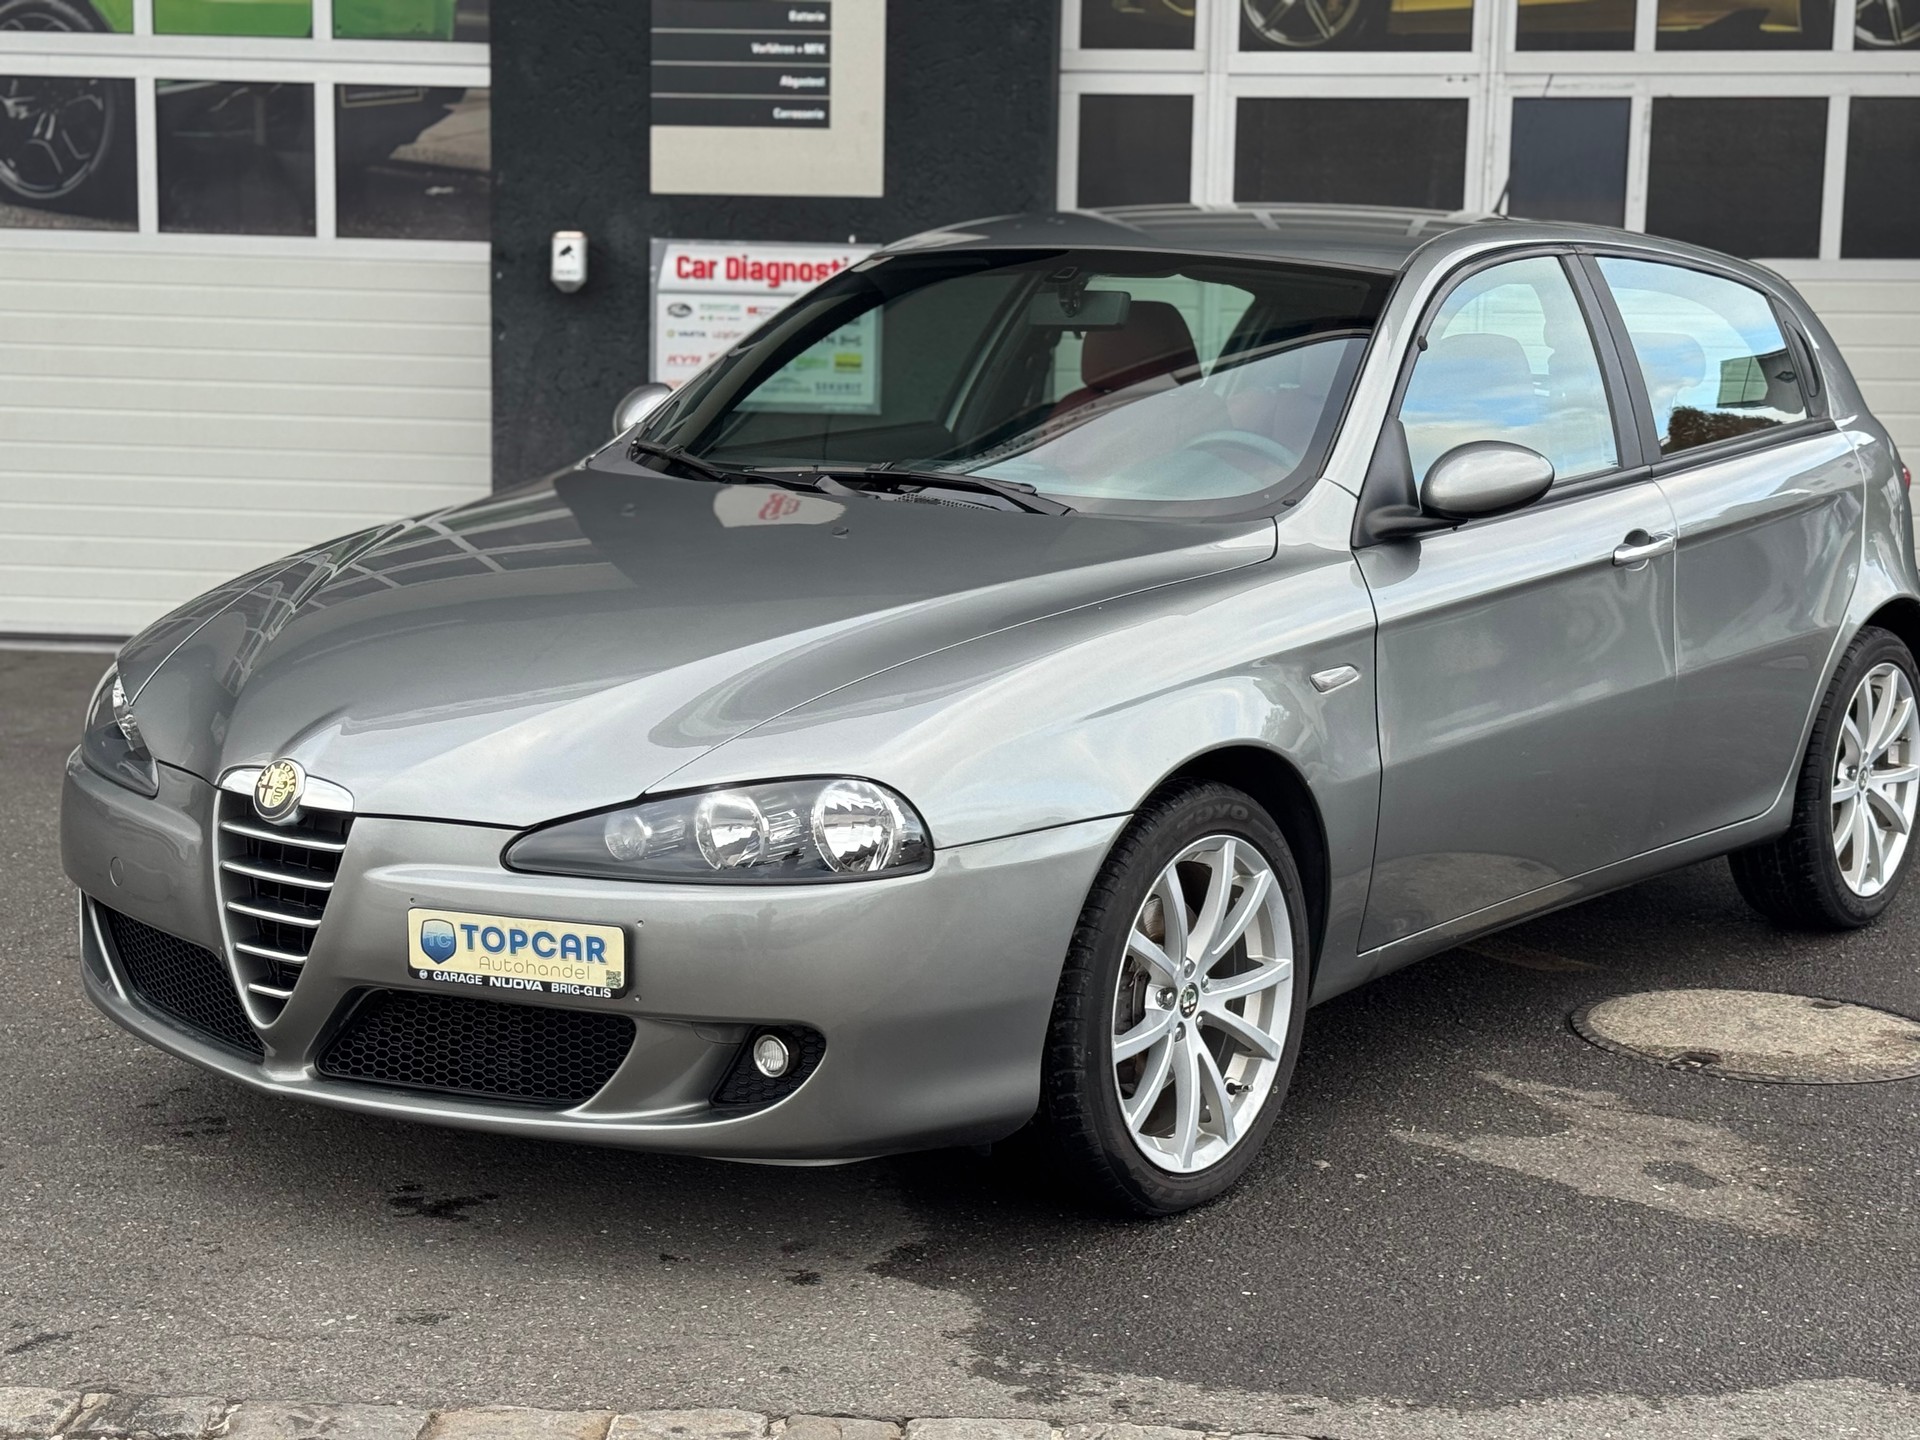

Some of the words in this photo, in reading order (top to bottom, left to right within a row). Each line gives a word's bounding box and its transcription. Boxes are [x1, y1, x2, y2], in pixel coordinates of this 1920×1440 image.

[676, 254, 717, 280] Car
[426, 931, 452, 949] TC
[460, 923, 607, 965] TOPCAR
[478, 955, 591, 980] Autohandel
[433, 970, 483, 986] GARAGE
[489, 976, 544, 992] NUOVA
[551, 983, 612, 999] BRIG-GLIS
